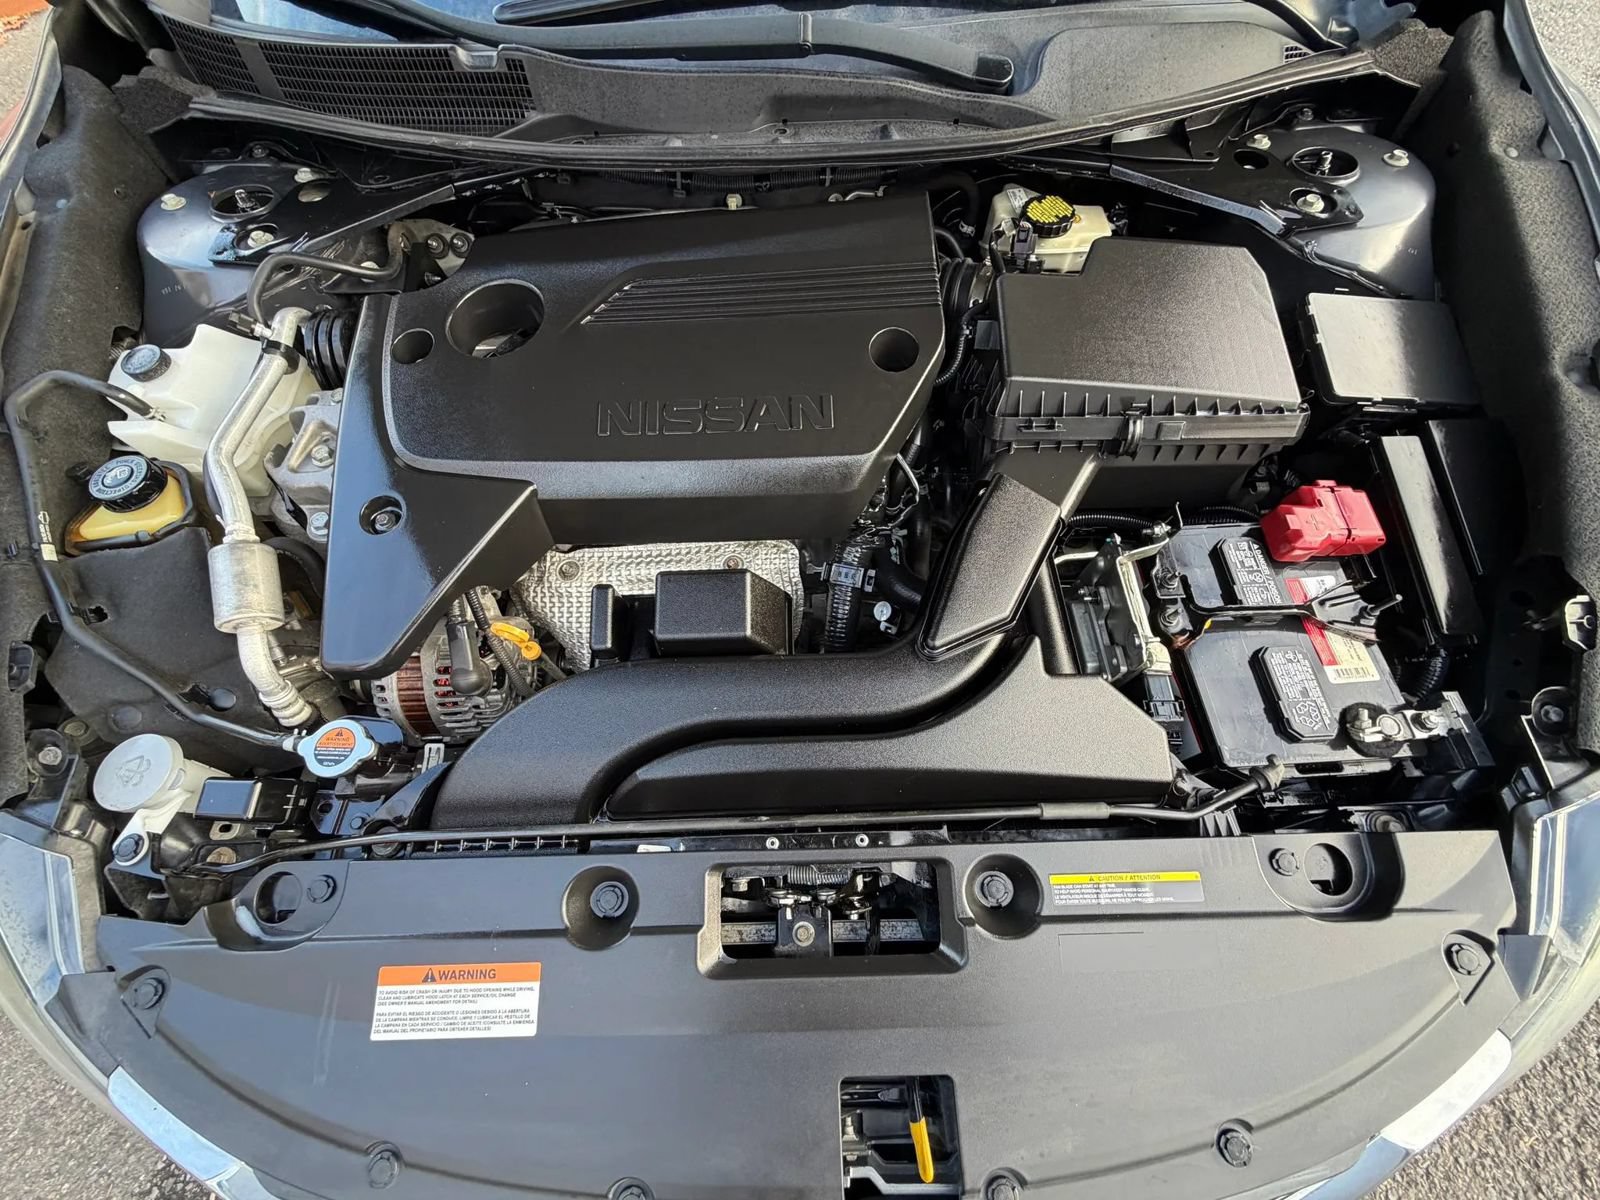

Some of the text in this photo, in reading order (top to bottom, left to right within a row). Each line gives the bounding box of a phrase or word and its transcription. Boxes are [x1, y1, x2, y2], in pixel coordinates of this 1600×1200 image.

[597, 394, 834, 436] NISSAN
[1256, 550, 1270, 575] DANGER
[1268, 580, 1283, 604] POISON
[438, 968, 496, 980] WARNING
